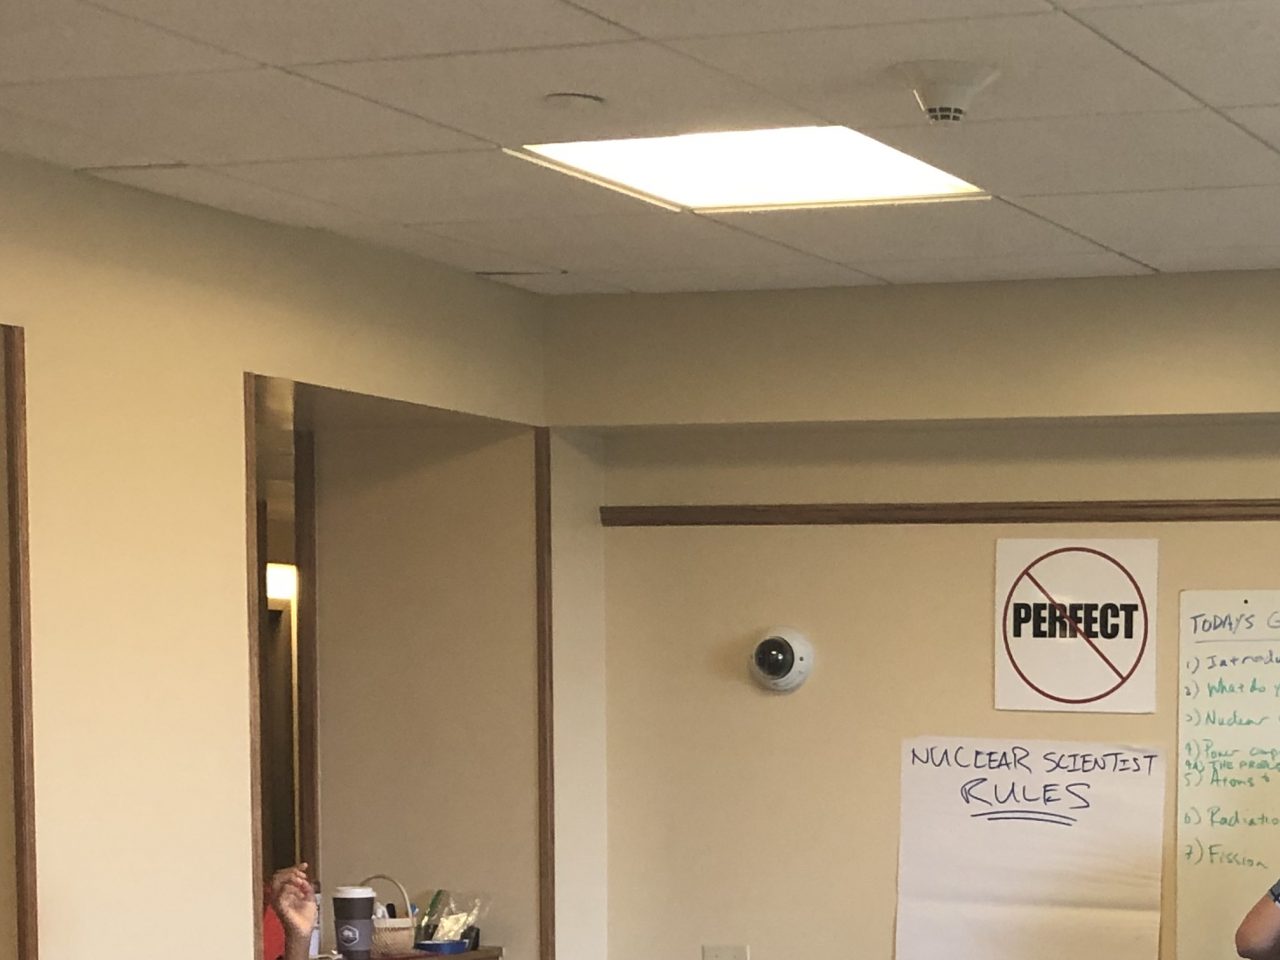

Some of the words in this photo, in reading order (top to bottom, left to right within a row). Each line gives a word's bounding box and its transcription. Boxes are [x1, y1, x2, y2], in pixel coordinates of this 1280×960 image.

[1012, 602, 1138, 639] PERFECT
[1207, 677, 1245, 698] What
[1249, 677, 1266, 693] do
[1205, 709, 1269, 727] Nuclear
[911, 746, 1032, 774] NUCLEAR
[1042, 752, 1159, 776] SCIENTIST
[960, 777, 1090, 809] RULES
[1208, 844, 1269, 869] Fission
